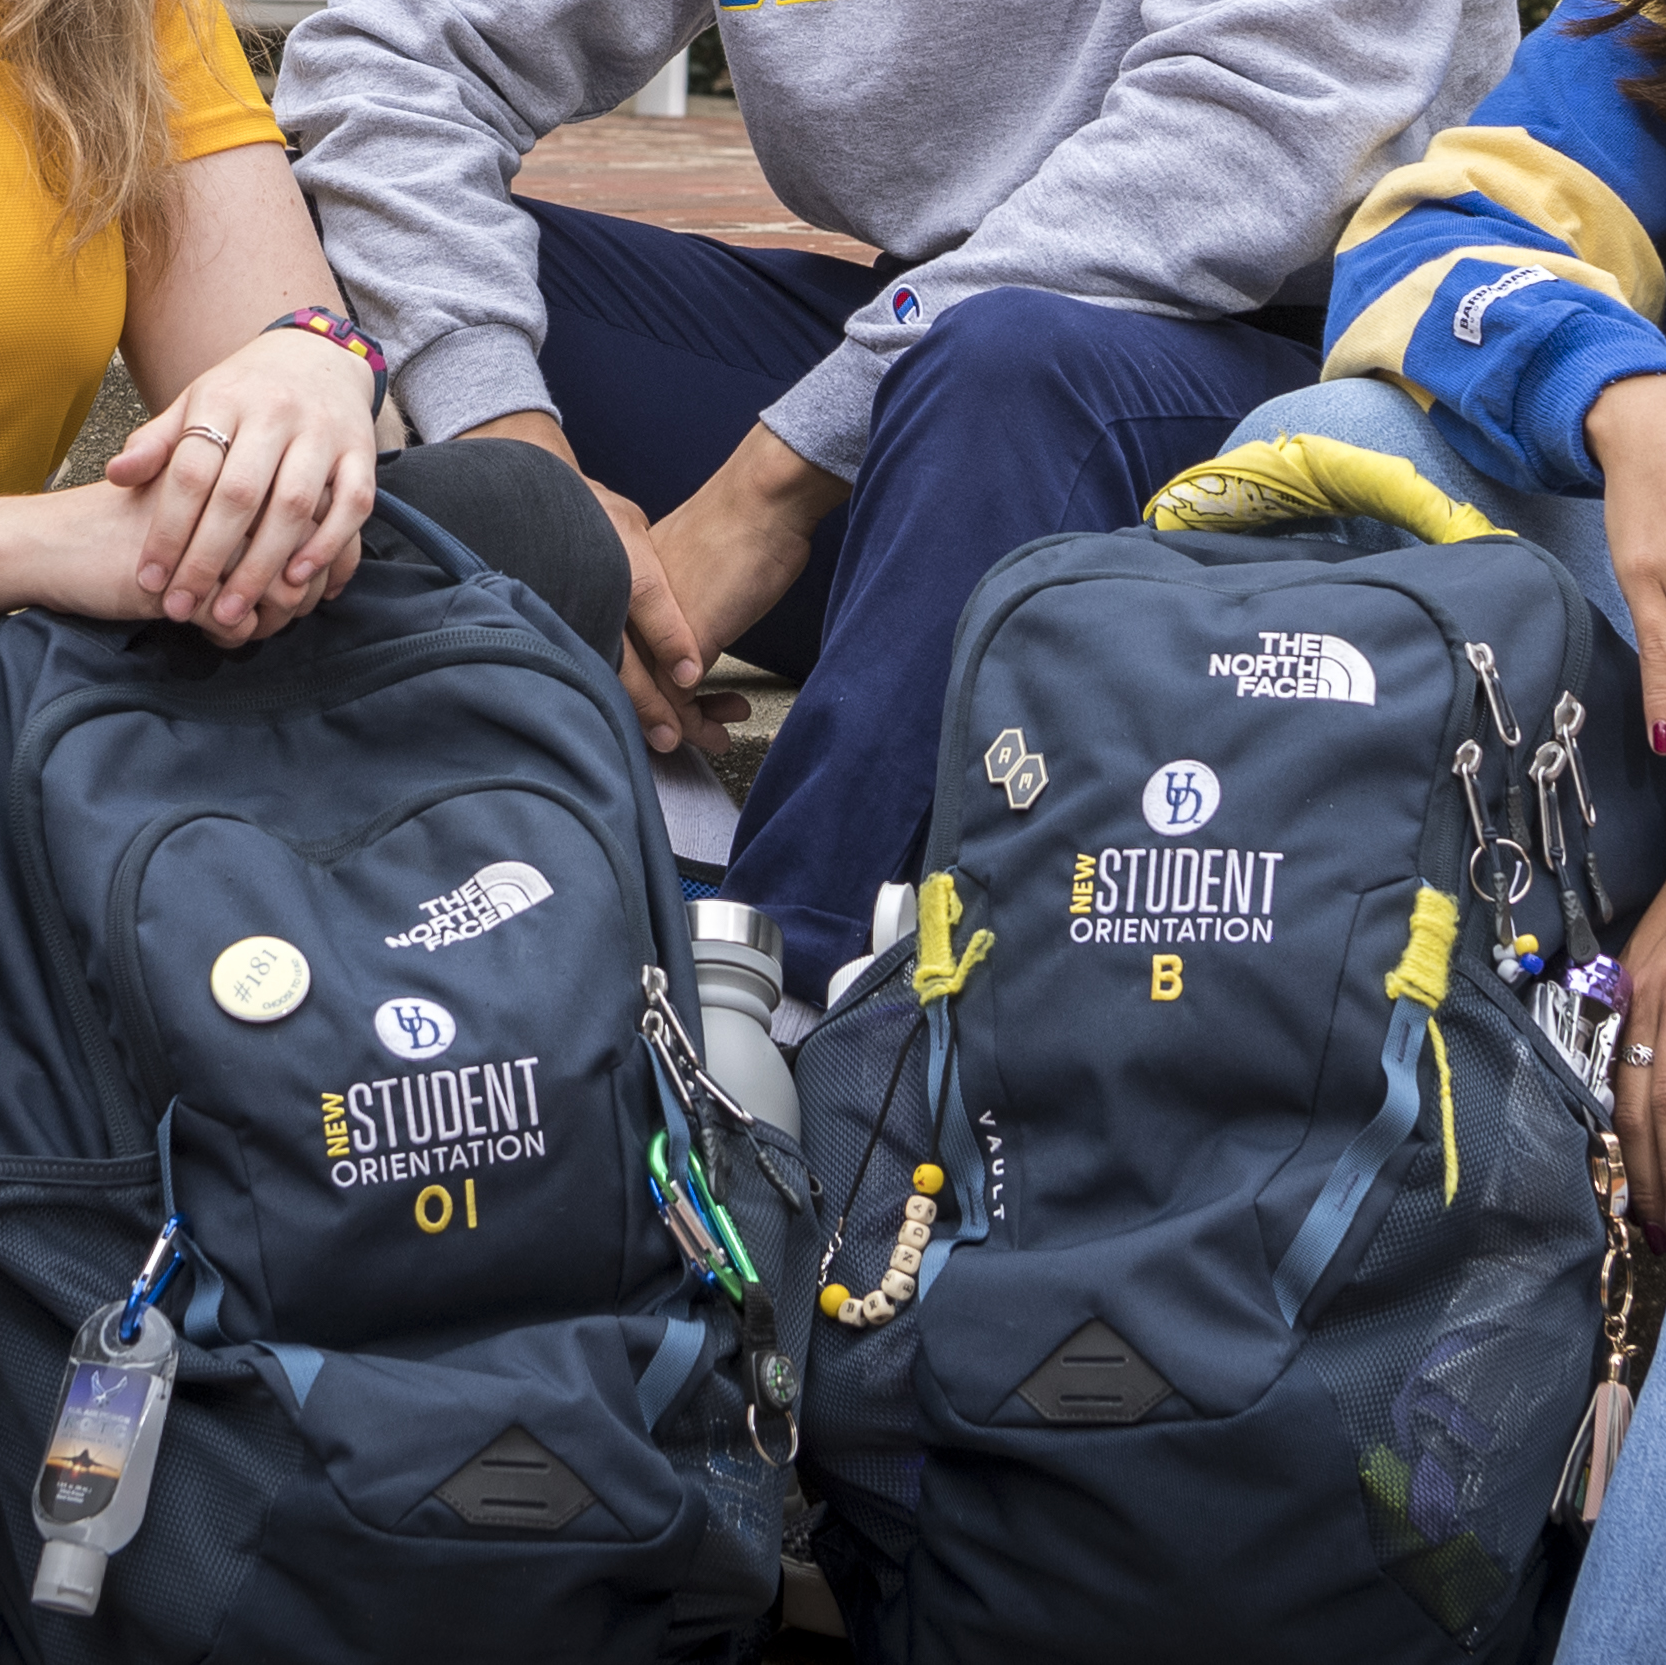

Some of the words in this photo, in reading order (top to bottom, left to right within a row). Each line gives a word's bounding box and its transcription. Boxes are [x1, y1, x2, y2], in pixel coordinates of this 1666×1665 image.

[1208, 653, 1319, 678] NORTH
[1258, 632, 1322, 657] THE
[1236, 676, 1317, 699] FACE
[1165, 772, 1202, 825] UD
[419, 877, 483, 916] THE
[1069, 853, 1097, 914] NEW
[1095, 847, 1284, 915] STUDENT
[385, 895, 493, 948] NORTH
[424, 909, 502, 951] FACE
[1070, 917, 1274, 944] ORIENTATION
[234, 949, 279, 1003] #181
[291, 978, 302, 989] TO
[1151, 954, 1184, 1001] B
[391, 1006, 446, 1049] UD
[322, 1093, 350, 1157] NEW
[348, 1057, 539, 1153] STUDENT
[331, 1131, 546, 1187] ORIENTATION
[979, 1109, 1005, 1220] VAULT
